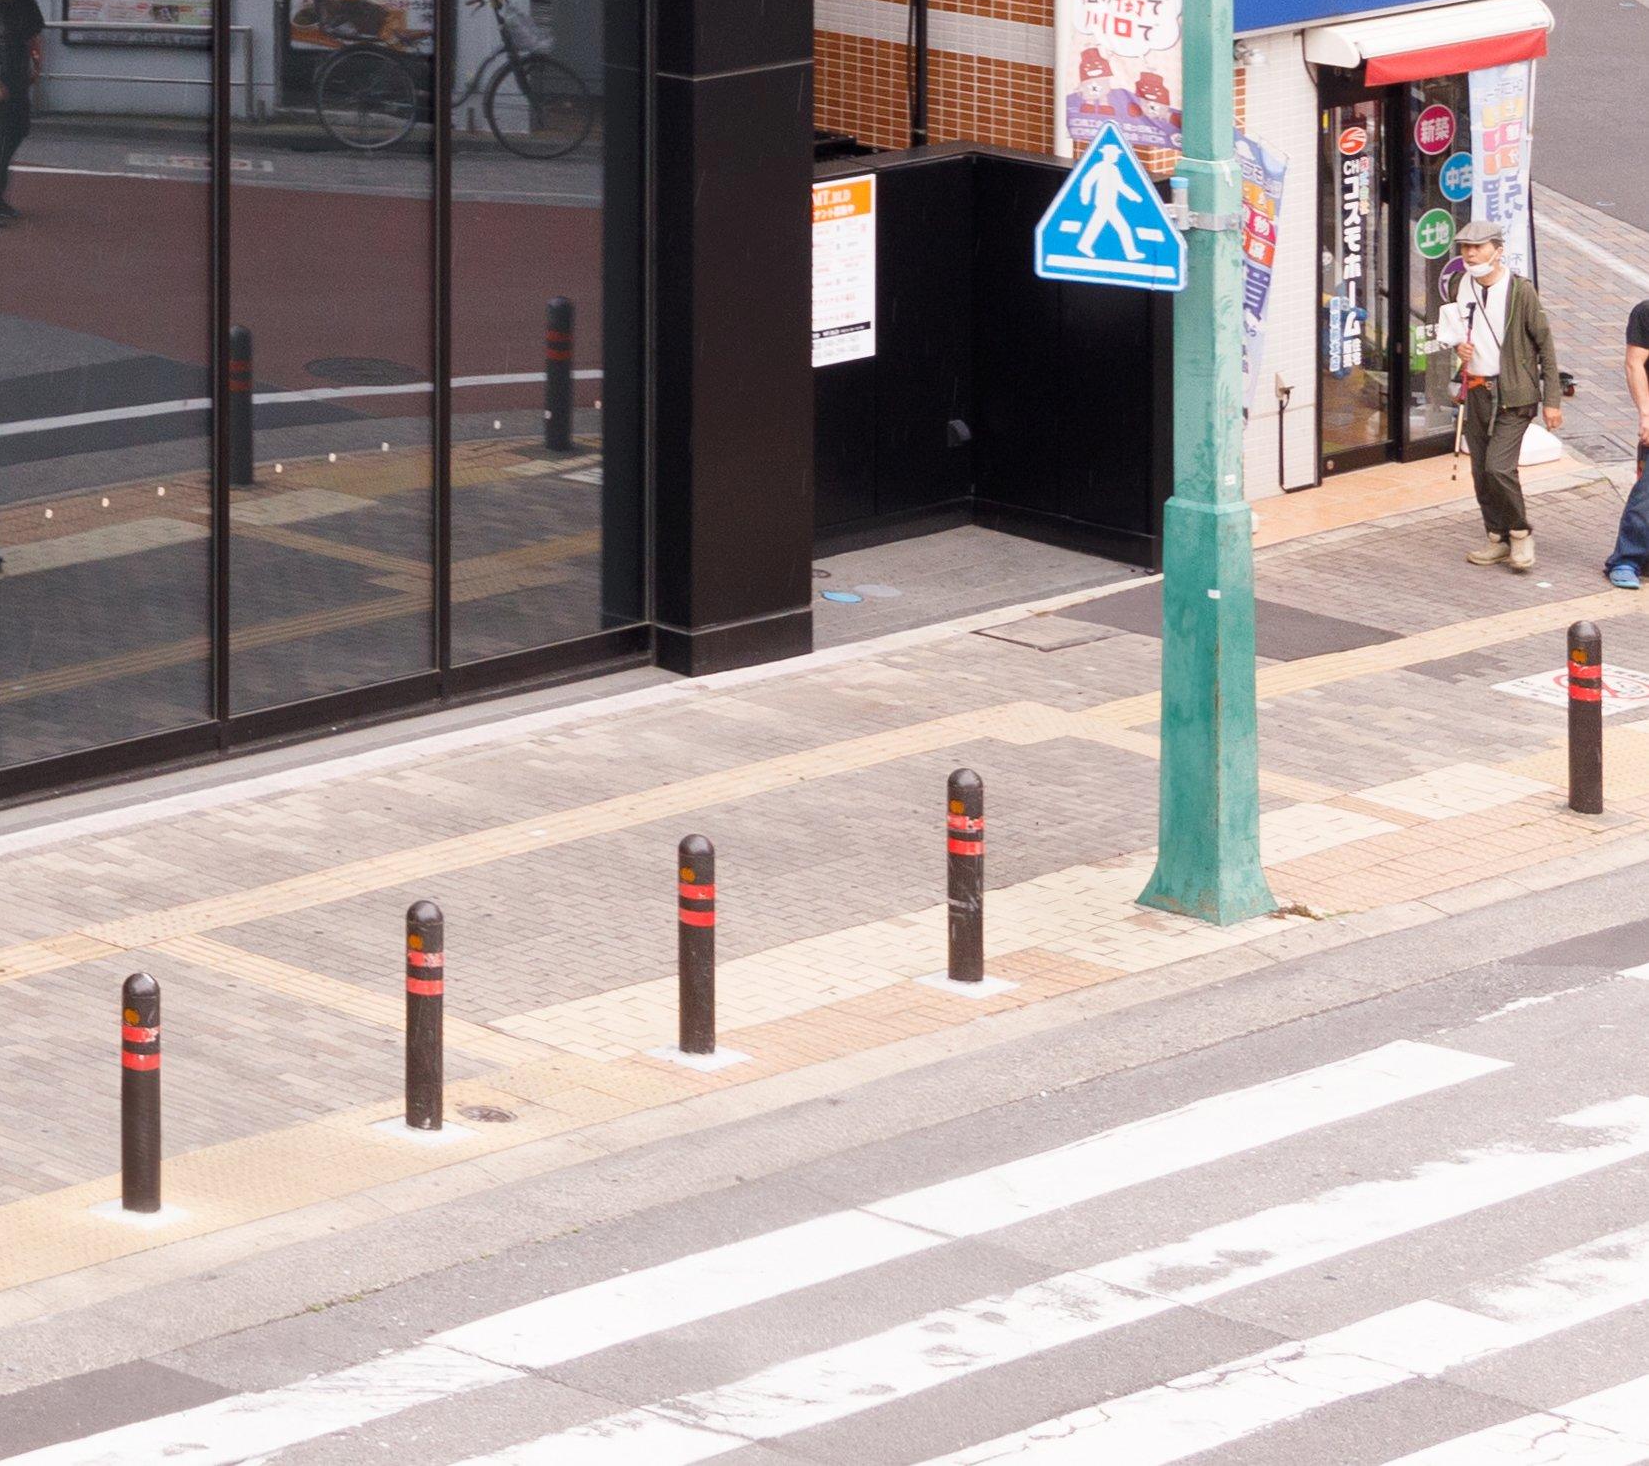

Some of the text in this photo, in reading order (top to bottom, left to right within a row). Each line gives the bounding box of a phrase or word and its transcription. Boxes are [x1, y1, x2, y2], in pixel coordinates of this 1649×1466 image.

[1085, 10, 1161, 42] 川口で
[1419, 117, 1451, 144] 新築
[1420, 219, 1451, 249] 土地
